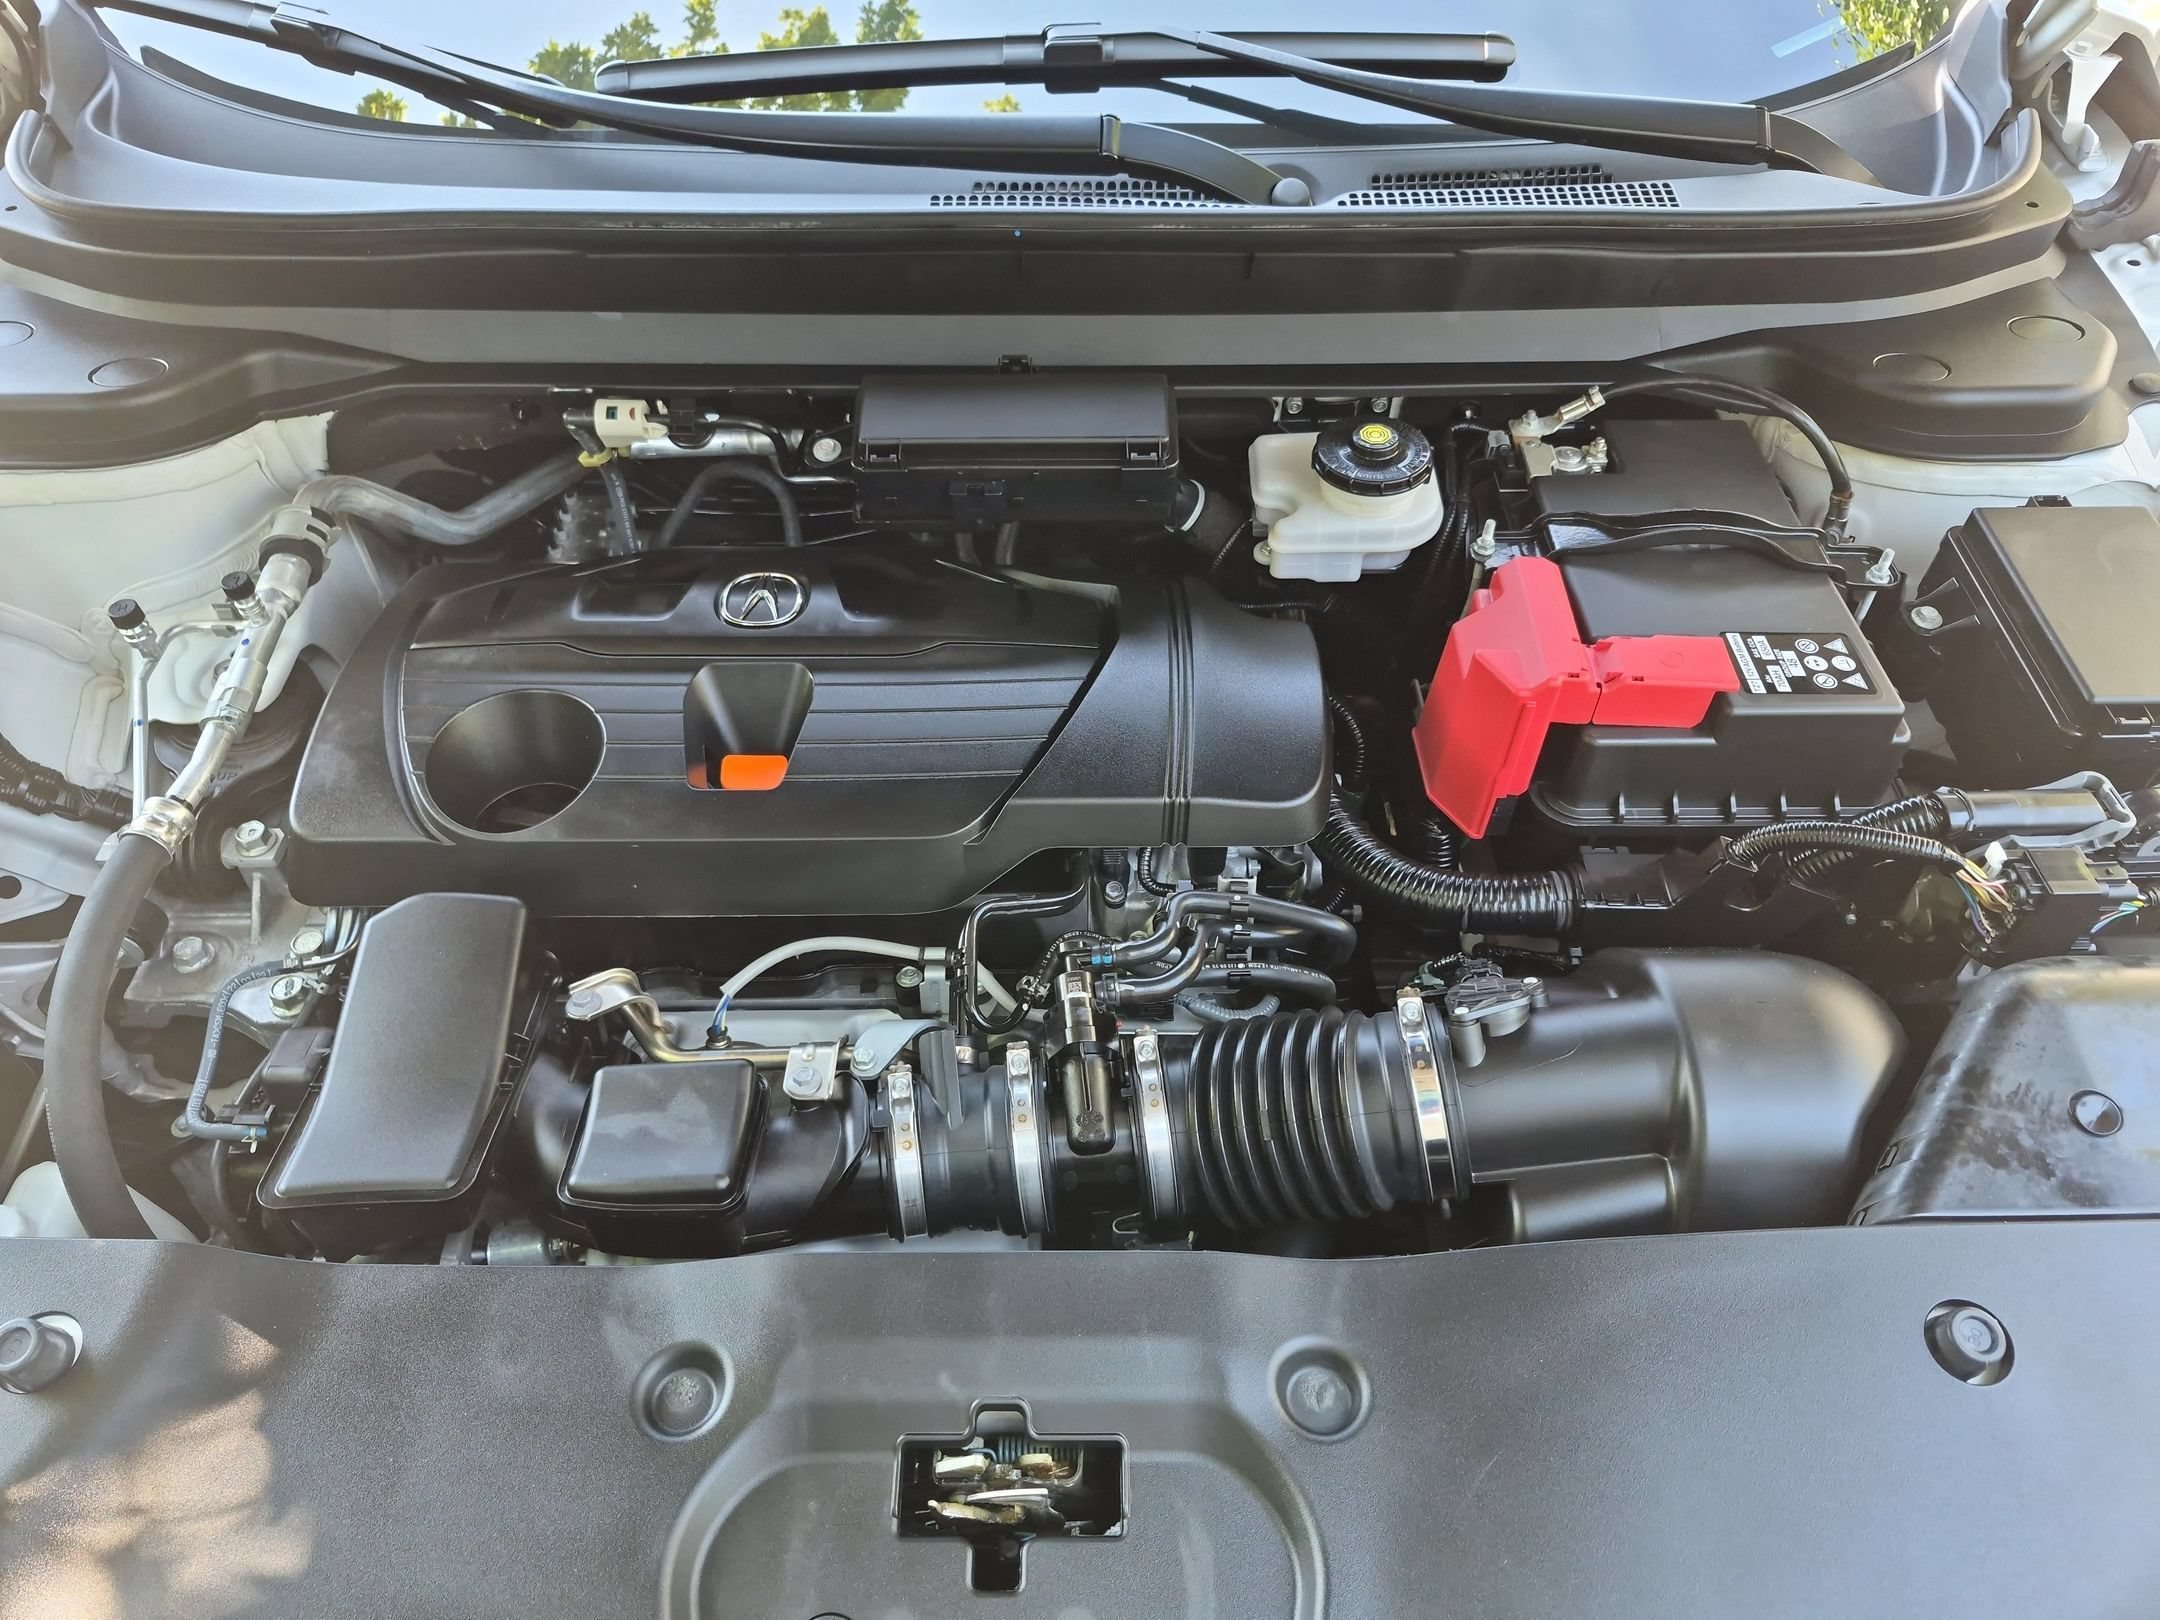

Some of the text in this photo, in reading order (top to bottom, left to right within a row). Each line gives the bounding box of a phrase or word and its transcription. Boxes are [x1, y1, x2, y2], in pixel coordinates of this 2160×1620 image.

[1732, 635, 1743, 653] Battery
[1757, 640, 1771, 656] 650A
[1738, 654, 1750, 667] AGM
[1787, 659, 1798, 668] 48
[1772, 670, 1787, 687] 70AH
